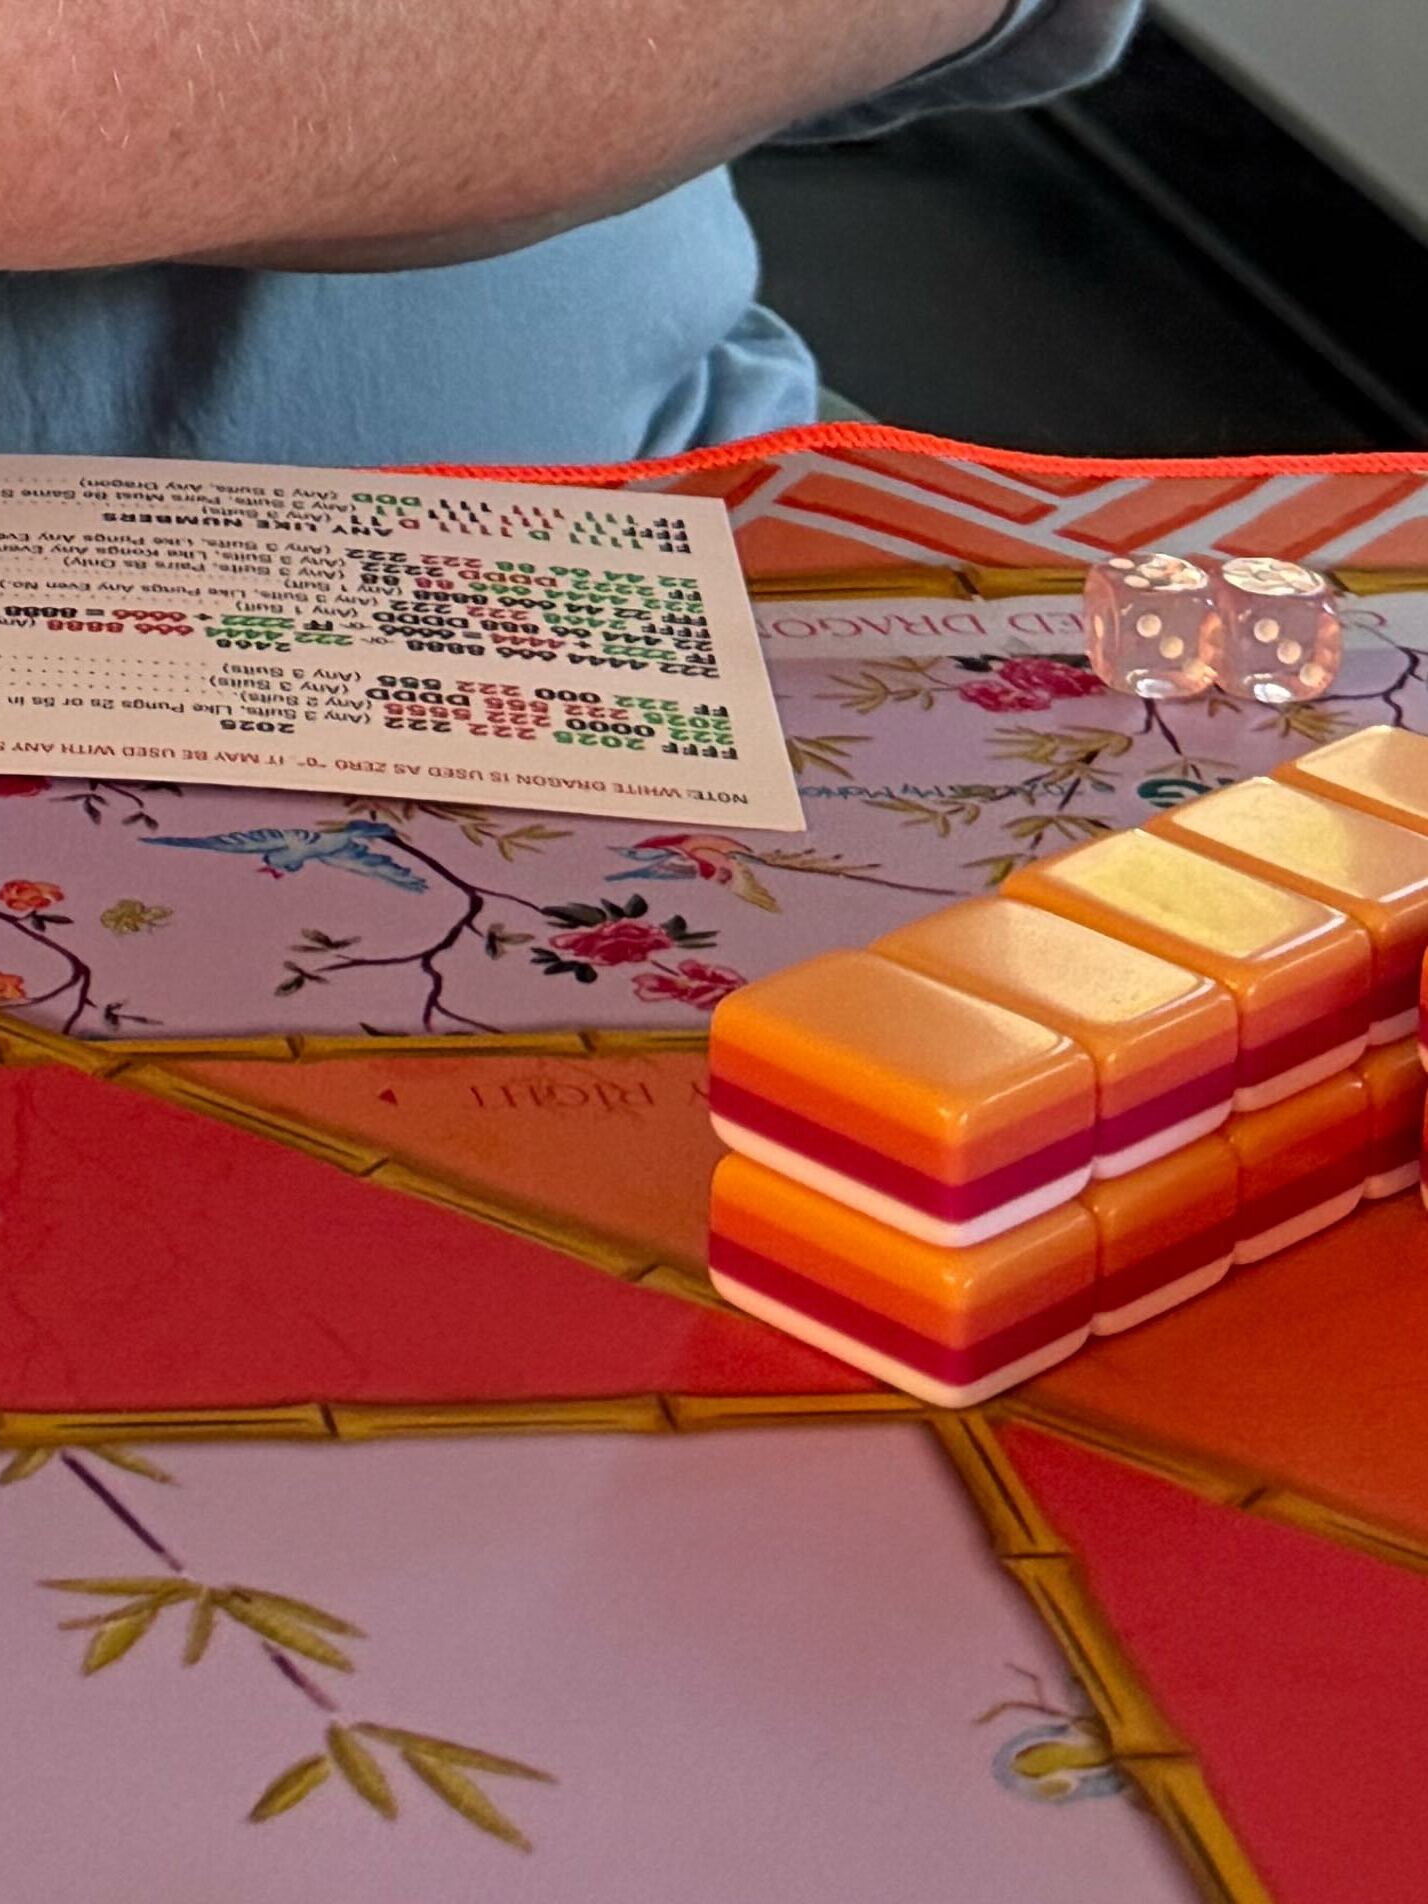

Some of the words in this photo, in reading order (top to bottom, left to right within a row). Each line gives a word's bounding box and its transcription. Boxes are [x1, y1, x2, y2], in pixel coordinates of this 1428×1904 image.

[102, 513, 242, 528] NUMBERS
[256, 520, 317, 532] LIKE
[331, 525, 393, 537] ANY
[216, 638, 291, 652] 2468
[377, 676, 442, 690] 555
[456, 681, 520, 697] 222
[7, 696, 25, 706] in
[62, 697, 83, 707] or
[365, 688, 470, 706] DDDD
[535, 688, 600, 703] 000
[121, 698, 185, 712] Pungs
[192, 702, 232, 715] Like
[484, 697, 549, 713] 555
[614, 696, 679, 711] 222
[693, 704, 729, 717] FF
[304, 712, 317, 723] 3
[324, 710, 371, 725] (Any
[384, 703, 471, 720] 5555
[485, 710, 551, 727] 222
[563, 704, 628, 721] 222
[220, 720, 294, 734] 2025
[385, 717, 451, 732] 222
[565, 719, 655, 737] 0000
[643, 713, 732, 731] 2025
[468, 723, 536, 740] 222
[669, 728, 734, 745] 222
[11, 742, 54, 753] ANY
[553, 731, 645, 750] 2025
[61, 744, 115, 755] WITH
[122, 746, 176, 758] USED
[183, 750, 207, 761] BE
[661, 743, 738, 760] FFFF
[214, 752, 260, 764] MAY
[262, 754, 284, 764] IT
[335, 760, 386, 773] ZERO
[394, 765, 420, 775] AS
[428, 767, 483, 781] USED
[490, 772, 509, 782] IS
[517, 774, 605, 791] DRAGON
[611, 783, 681, 798] WHITE
[687, 790, 748, 804] NOTE:
